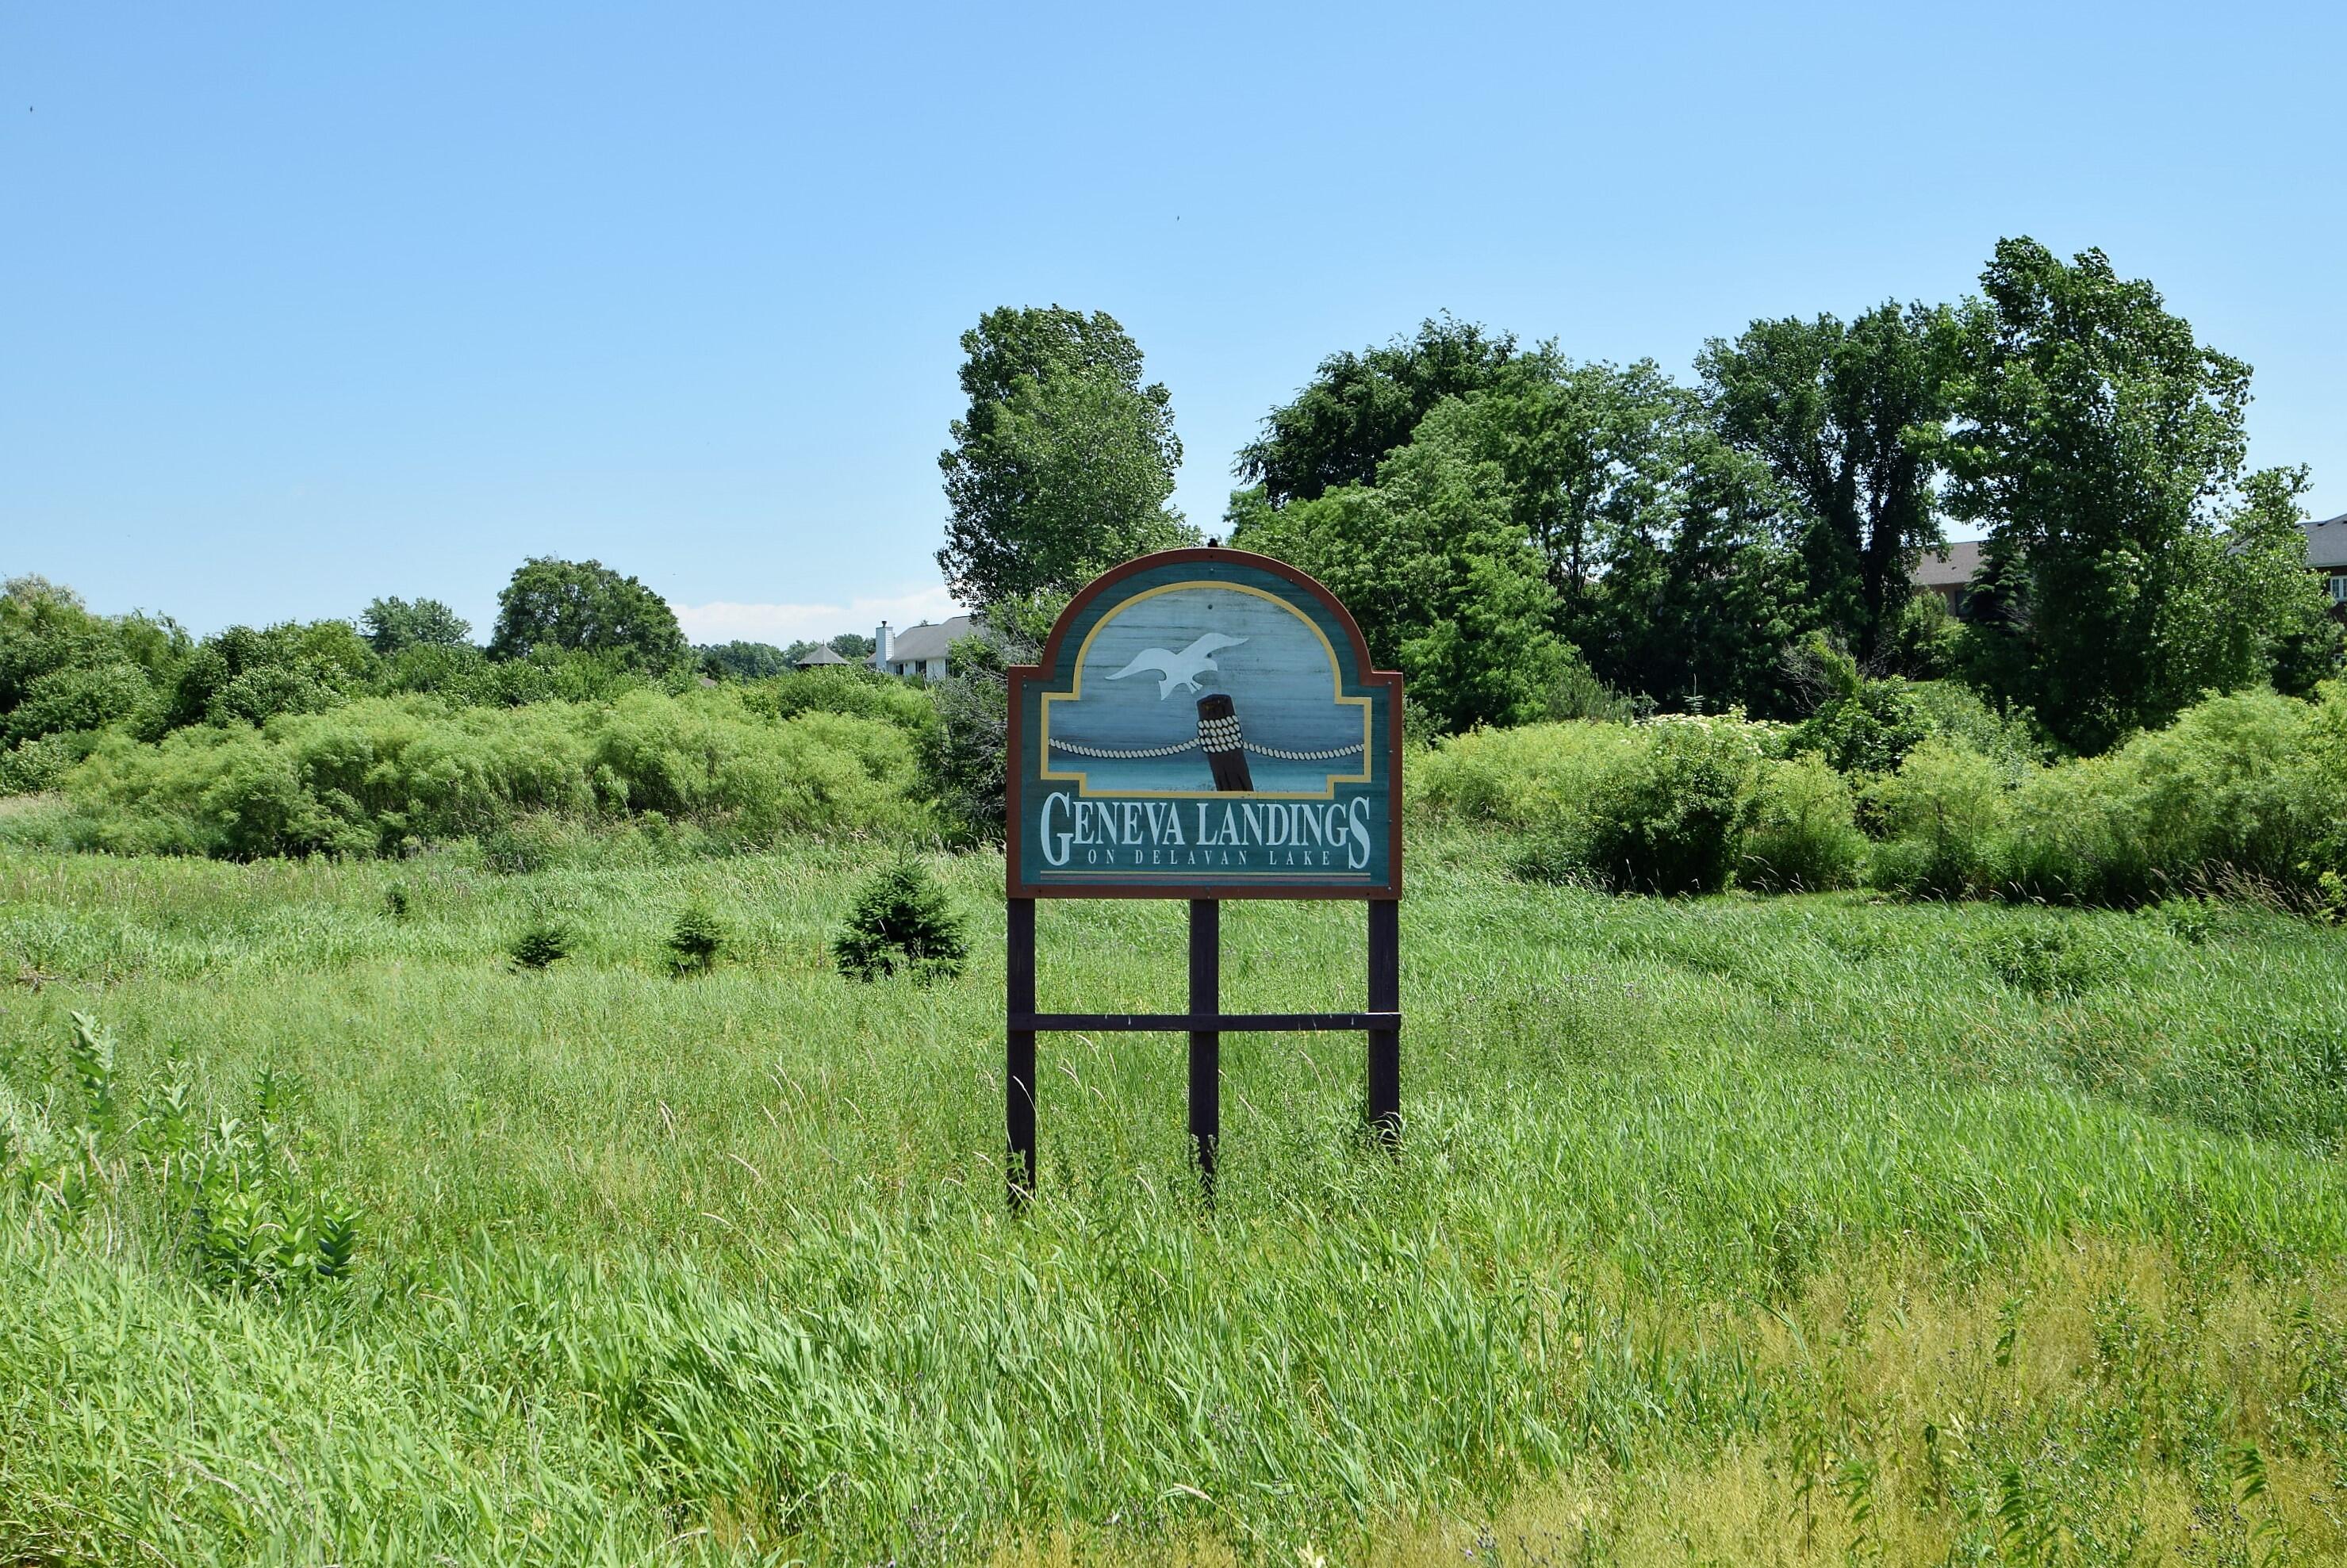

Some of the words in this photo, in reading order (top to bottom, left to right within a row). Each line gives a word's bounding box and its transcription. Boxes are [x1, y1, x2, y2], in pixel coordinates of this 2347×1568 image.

[1040, 792, 1185, 866] GENEVA
[1196, 796, 1371, 869] LANDINGS
[1087, 849, 1114, 865] ON
[1135, 849, 1248, 865] DELAVAN
[1269, 850, 1330, 866] LAKE
